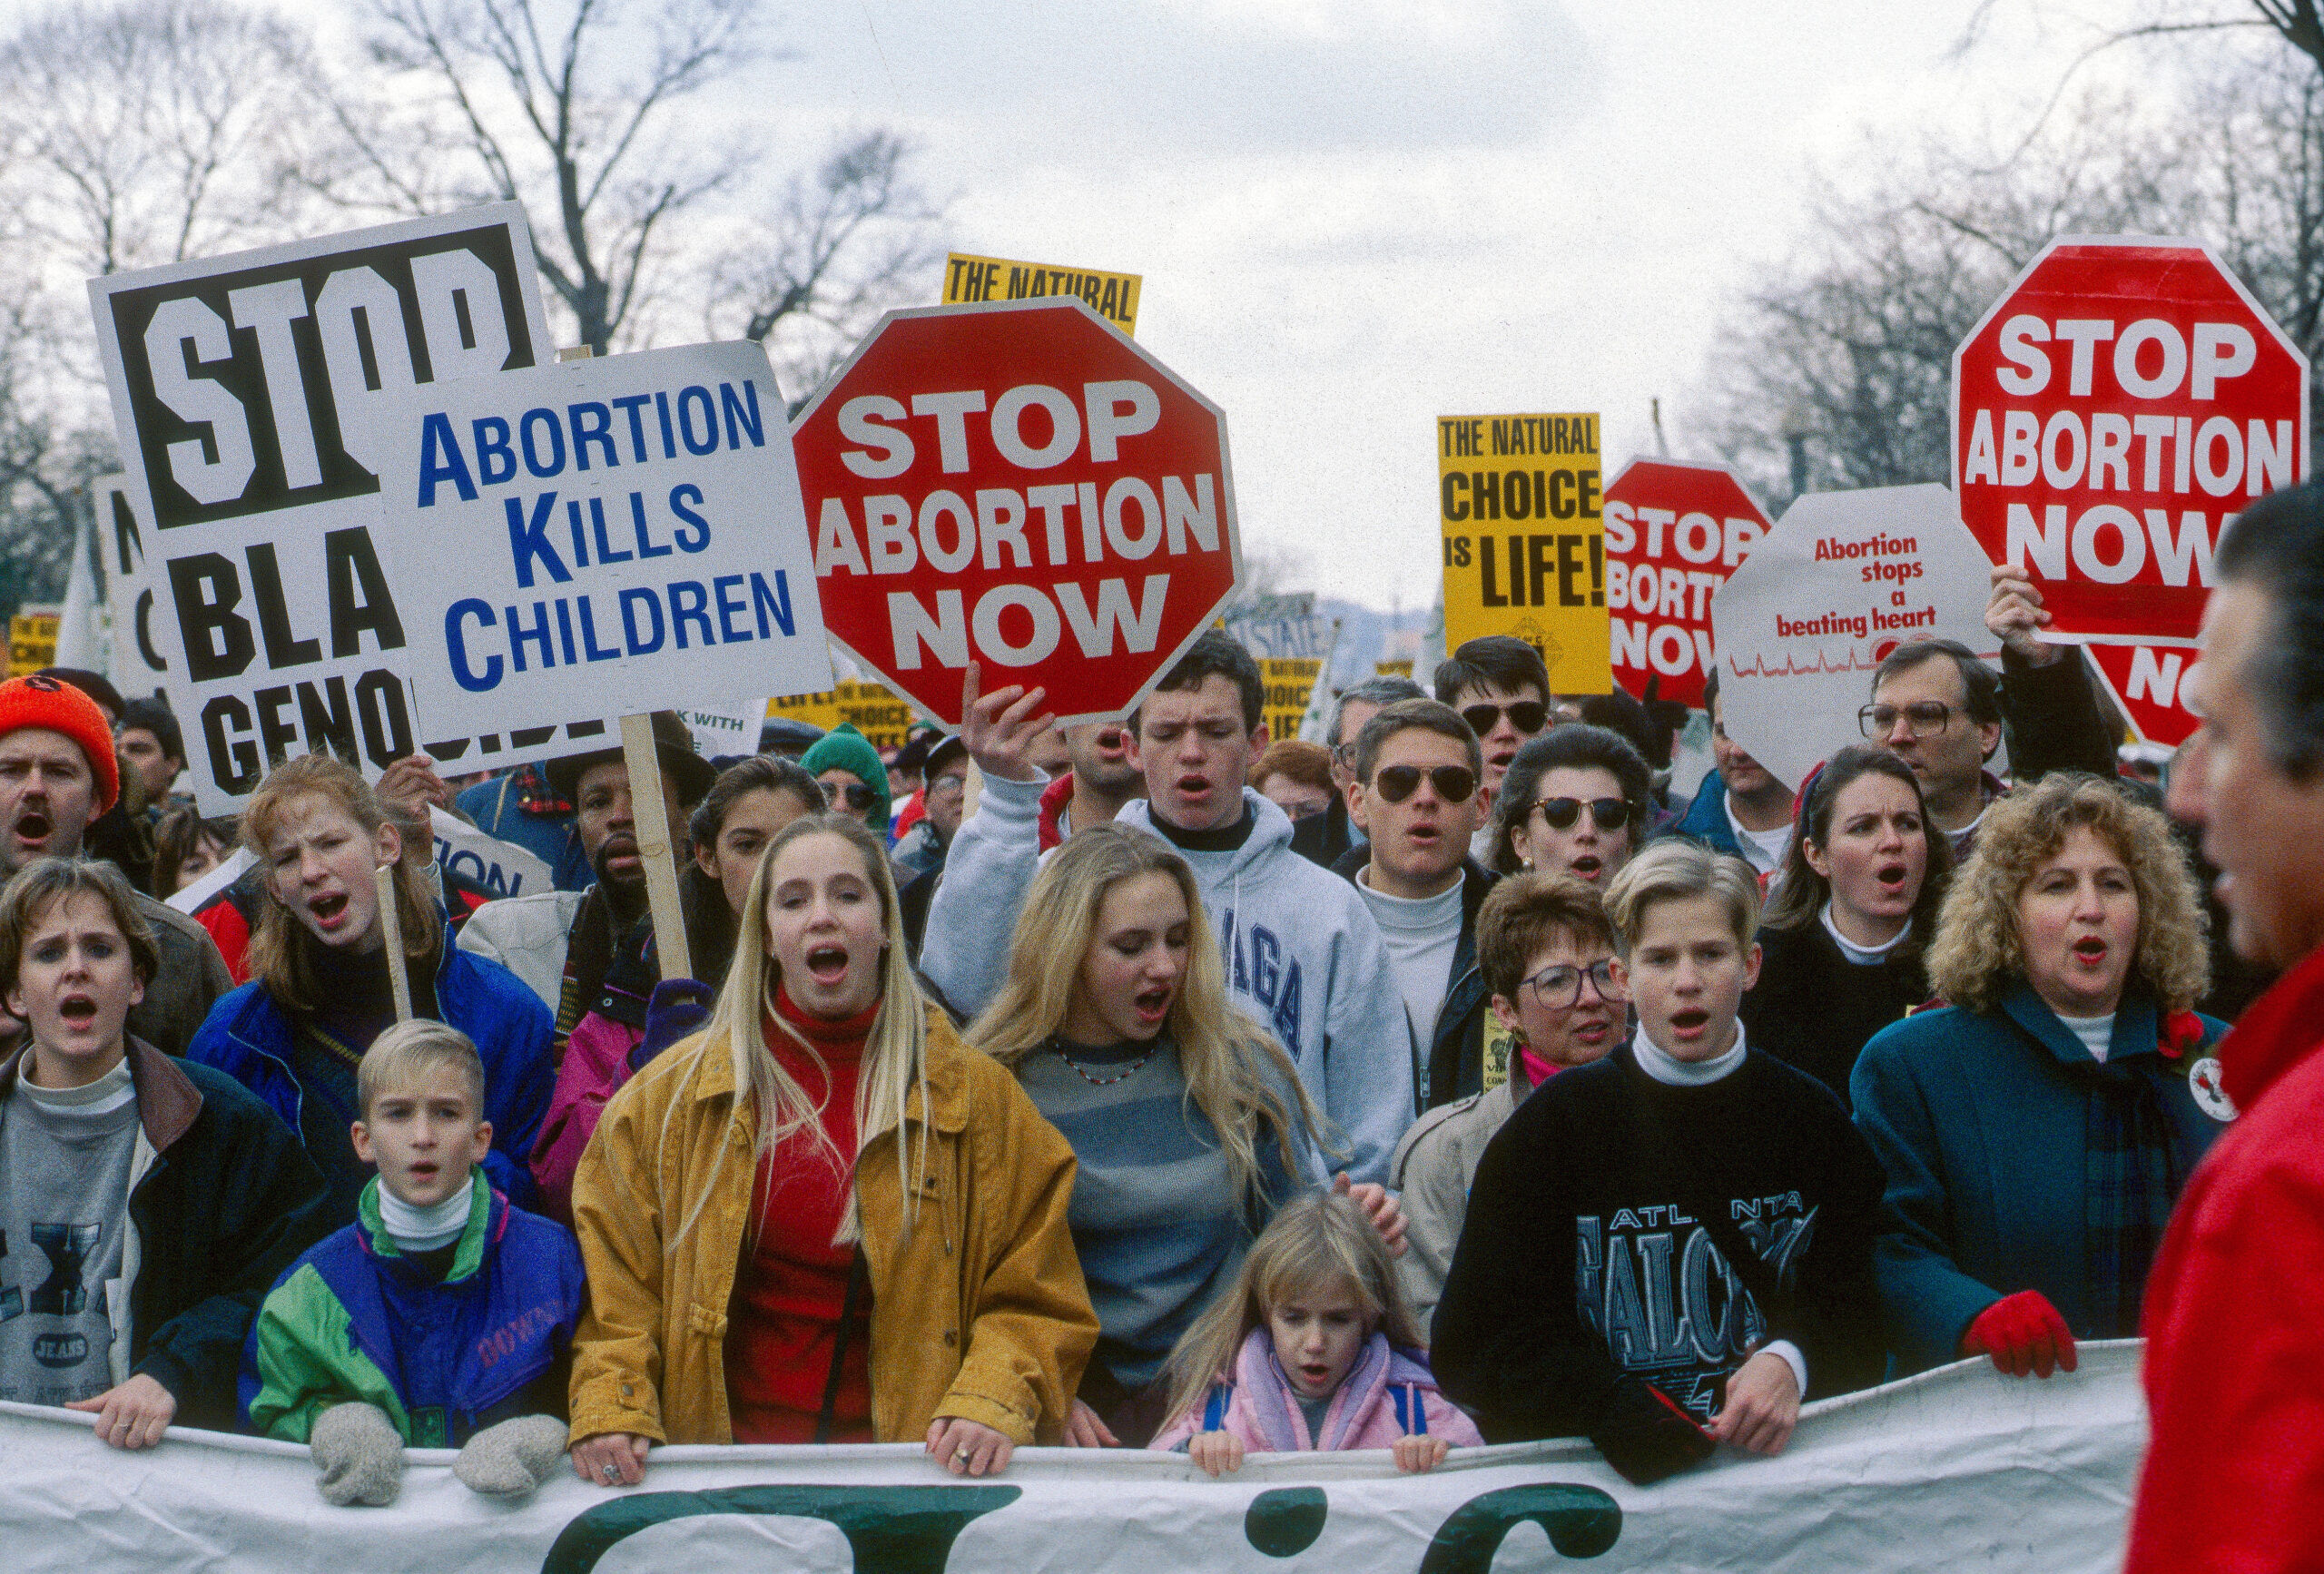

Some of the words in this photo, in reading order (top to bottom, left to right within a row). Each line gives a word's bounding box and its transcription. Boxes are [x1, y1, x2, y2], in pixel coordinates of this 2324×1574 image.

[950, 259, 1000, 302] THE
[143, 247, 511, 506] STOP
[1995, 314, 2258, 400] STOP
[418, 379, 765, 508] ABORTION
[837, 379, 1161, 479] STOP
[1441, 419, 1483, 457] THE
[1492, 417, 1599, 457] NATURAL
[1965, 408, 2294, 497] ABORTION
[815, 473, 1220, 577] ABORTION
[1442, 468, 1601, 522] CHOICE
[504, 483, 712, 589] KILLS
[1604, 499, 1765, 568] STOP
[1816, 532, 1917, 561] Abortion
[166, 525, 407, 684] BLA
[1443, 536, 1472, 567] IS
[1479, 534, 1605, 607] LIFE!
[1861, 561, 1924, 585] stops
[1891, 590, 1905, 606] a
[444, 568, 797, 693] CHILDREN
[887, 573, 1171, 671] NOW
[1776, 611, 1867, 638] beating
[1872, 605, 1935, 631] heart
[694, 711, 744, 732] WITH
[1609, 1190, 1804, 1231] ATLNTA
